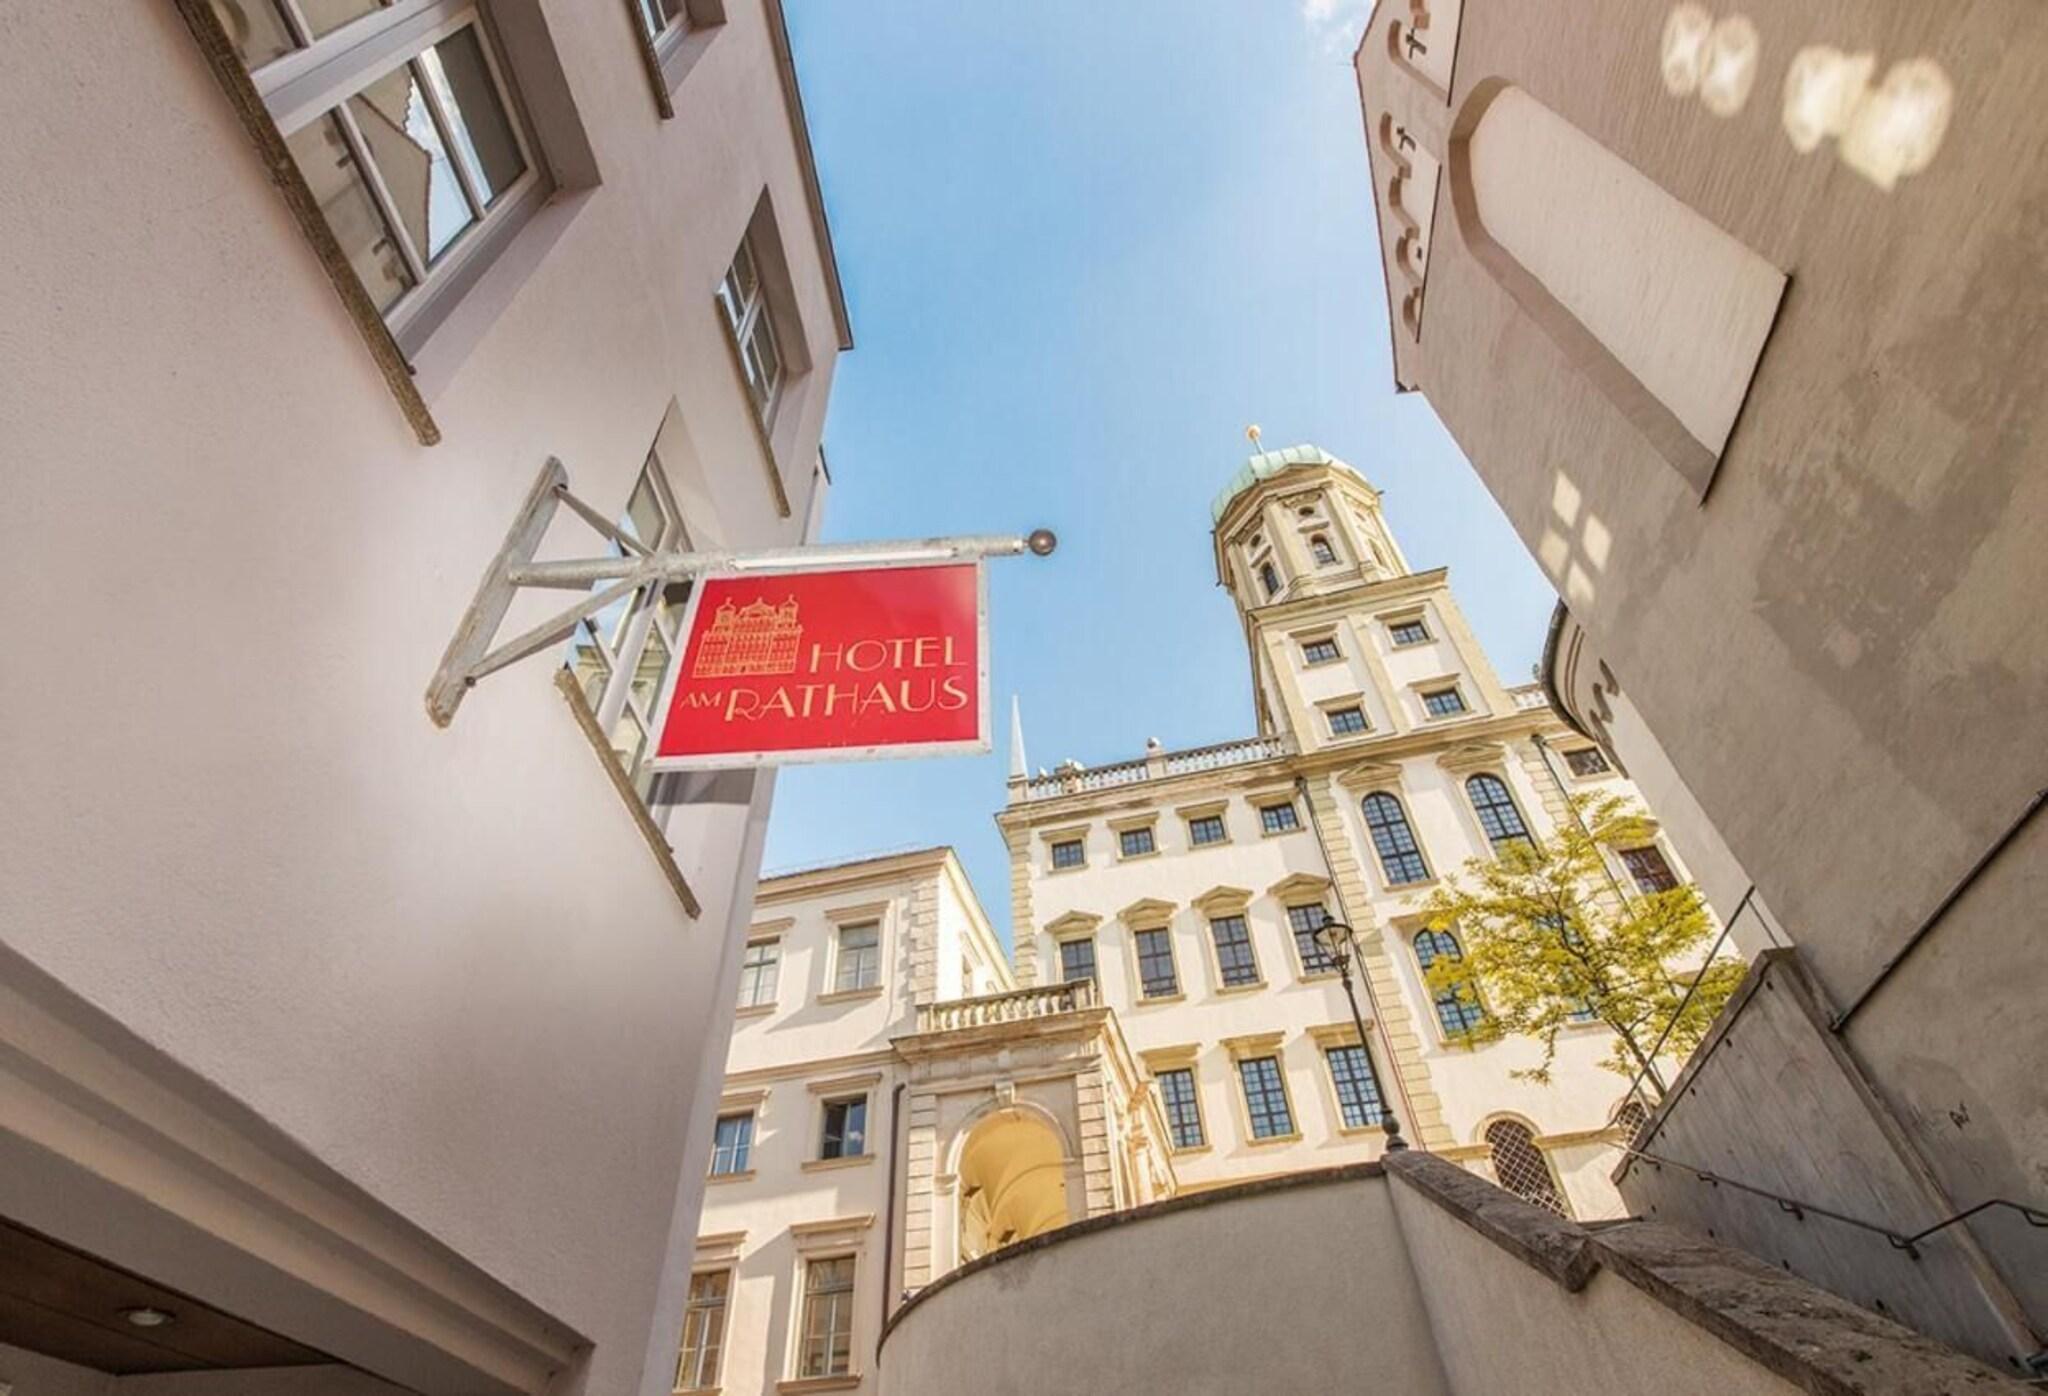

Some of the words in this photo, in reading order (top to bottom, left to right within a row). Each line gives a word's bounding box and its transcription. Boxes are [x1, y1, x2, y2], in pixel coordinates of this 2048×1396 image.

[810, 636, 967, 673] HOTEL
[681, 693, 722, 709] AM
[724, 676, 969, 722] RATHAUS
